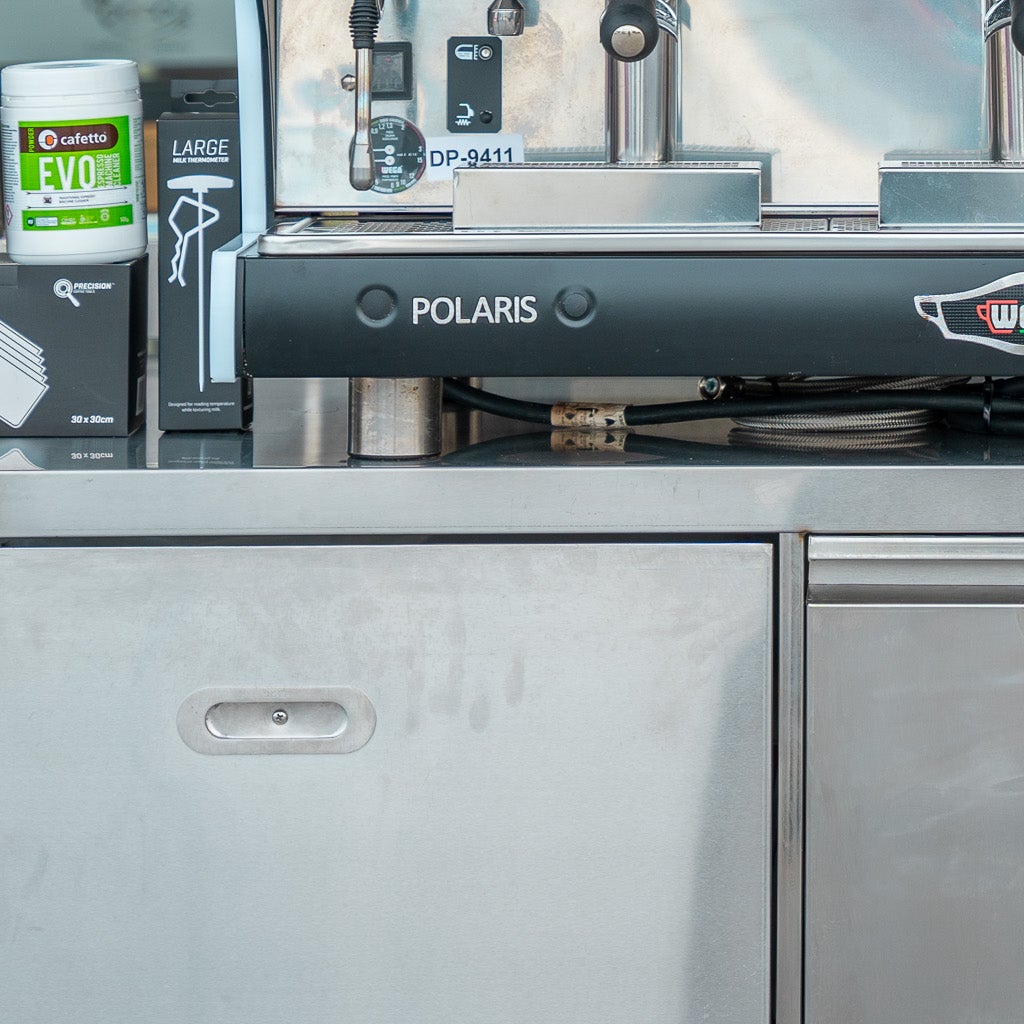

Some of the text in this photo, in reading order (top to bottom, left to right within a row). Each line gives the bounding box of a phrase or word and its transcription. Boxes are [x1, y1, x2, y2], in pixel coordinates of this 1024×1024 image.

[60, 132, 108, 145] cafetto
[172, 139, 229, 156] LARGE
[112, 152, 120, 186] CLEANER
[430, 147, 512, 167] DP-9411
[40, 155, 96, 190] EVO
[412, 295, 538, 325] POLARIS
